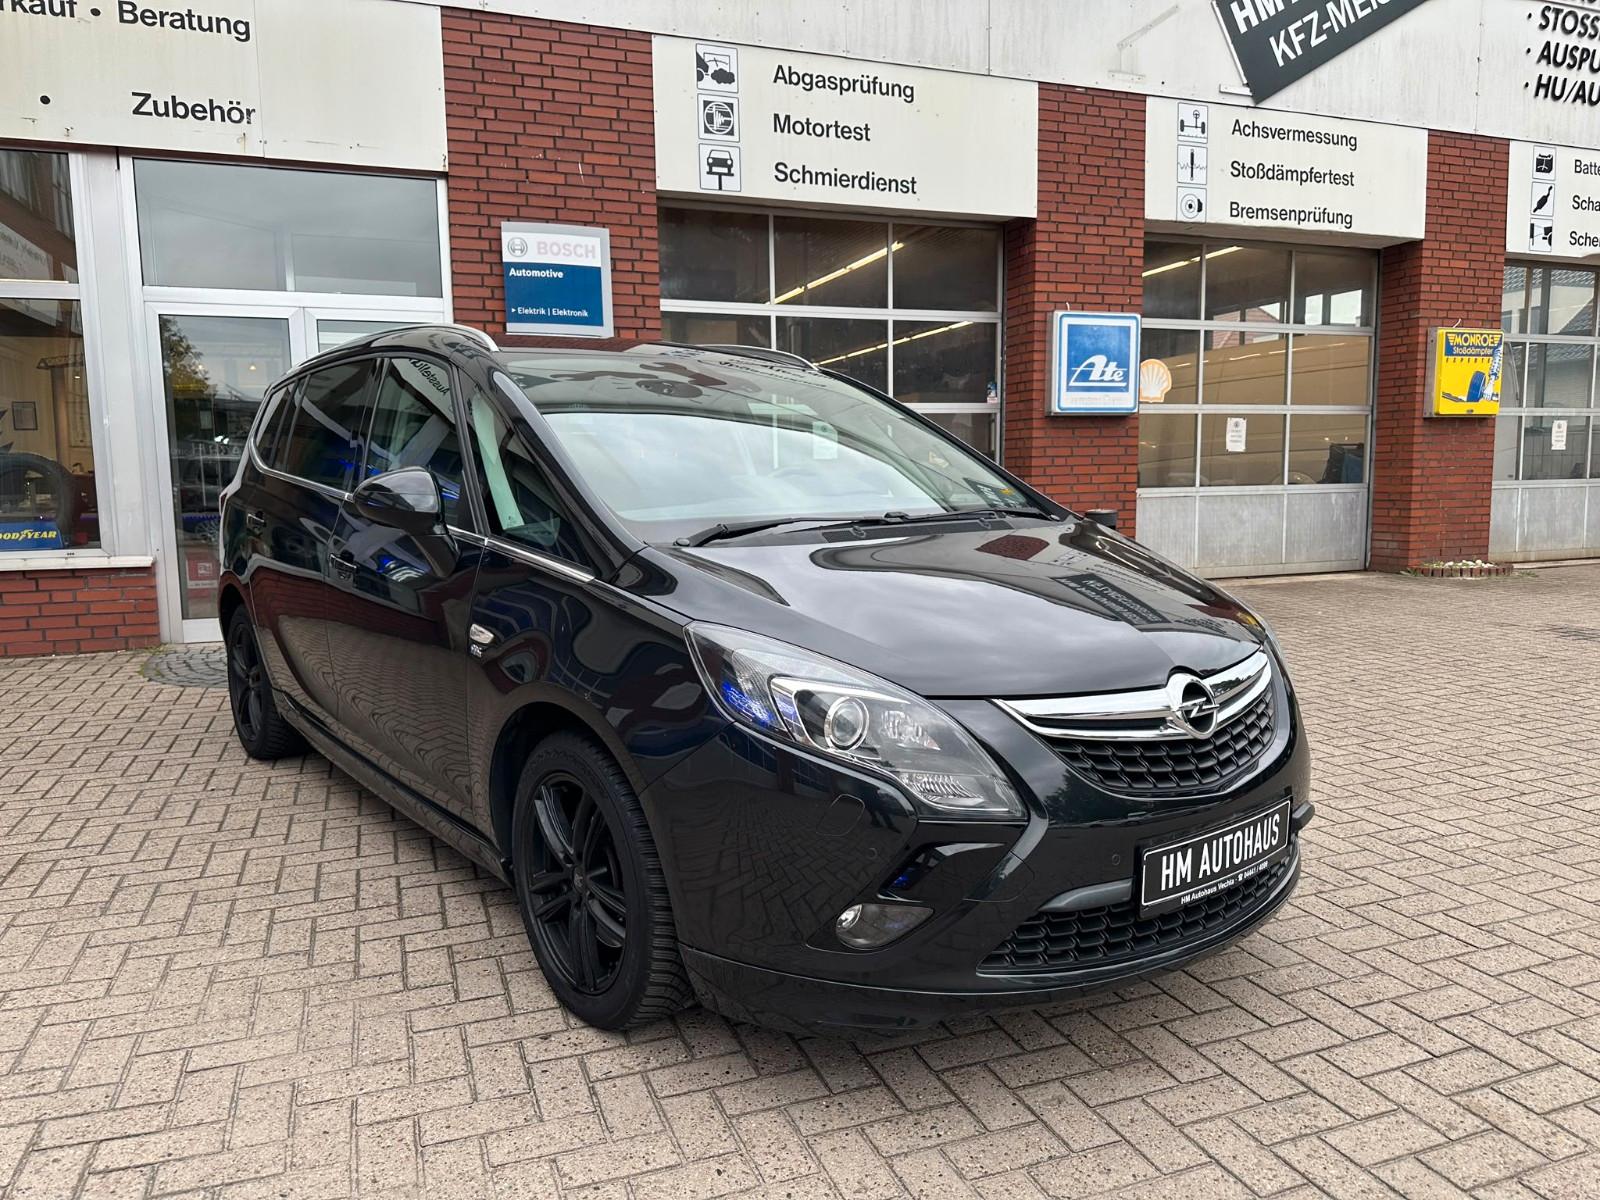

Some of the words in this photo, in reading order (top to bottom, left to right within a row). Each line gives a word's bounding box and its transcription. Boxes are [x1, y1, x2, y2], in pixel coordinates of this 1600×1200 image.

[118, 0, 251, 43] Beratung
[1230, 0, 1285, 34] HM
[1269, 0, 1391, 67] KFZ-ME
[1536, 40, 1600, 74] AUSPU
[772, 64, 915, 104] Abgasprüfung
[1534, 73, 1600, 106] HU/AU
[131, 91, 256, 125] Zubehör
[773, 113, 871, 142] Motortest
[1231, 118, 1358, 151] Achsvermessung
[774, 162, 917, 194] Schmierdienst
[1230, 160, 1355, 187] Stoßdämpfertest
[1229, 201, 1353, 229] Bremsenprüfung
[1572, 194, 1600, 212] Scha
[536, 241, 597, 258] BOSCH
[1569, 230, 1600, 247] Sche
[509, 267, 564, 279] Automotive
[517, 306, 546, 315] Elektrik
[552, 308, 589, 317] Elektronik
[1454, 333, 1494, 346] MONROE
[1161, 848, 1192, 891] HM
[1199, 813, 1280, 879] AUTOHAUS
[1181, 894, 1191, 904] HM
[1191, 886, 1217, 901] Autohaus
